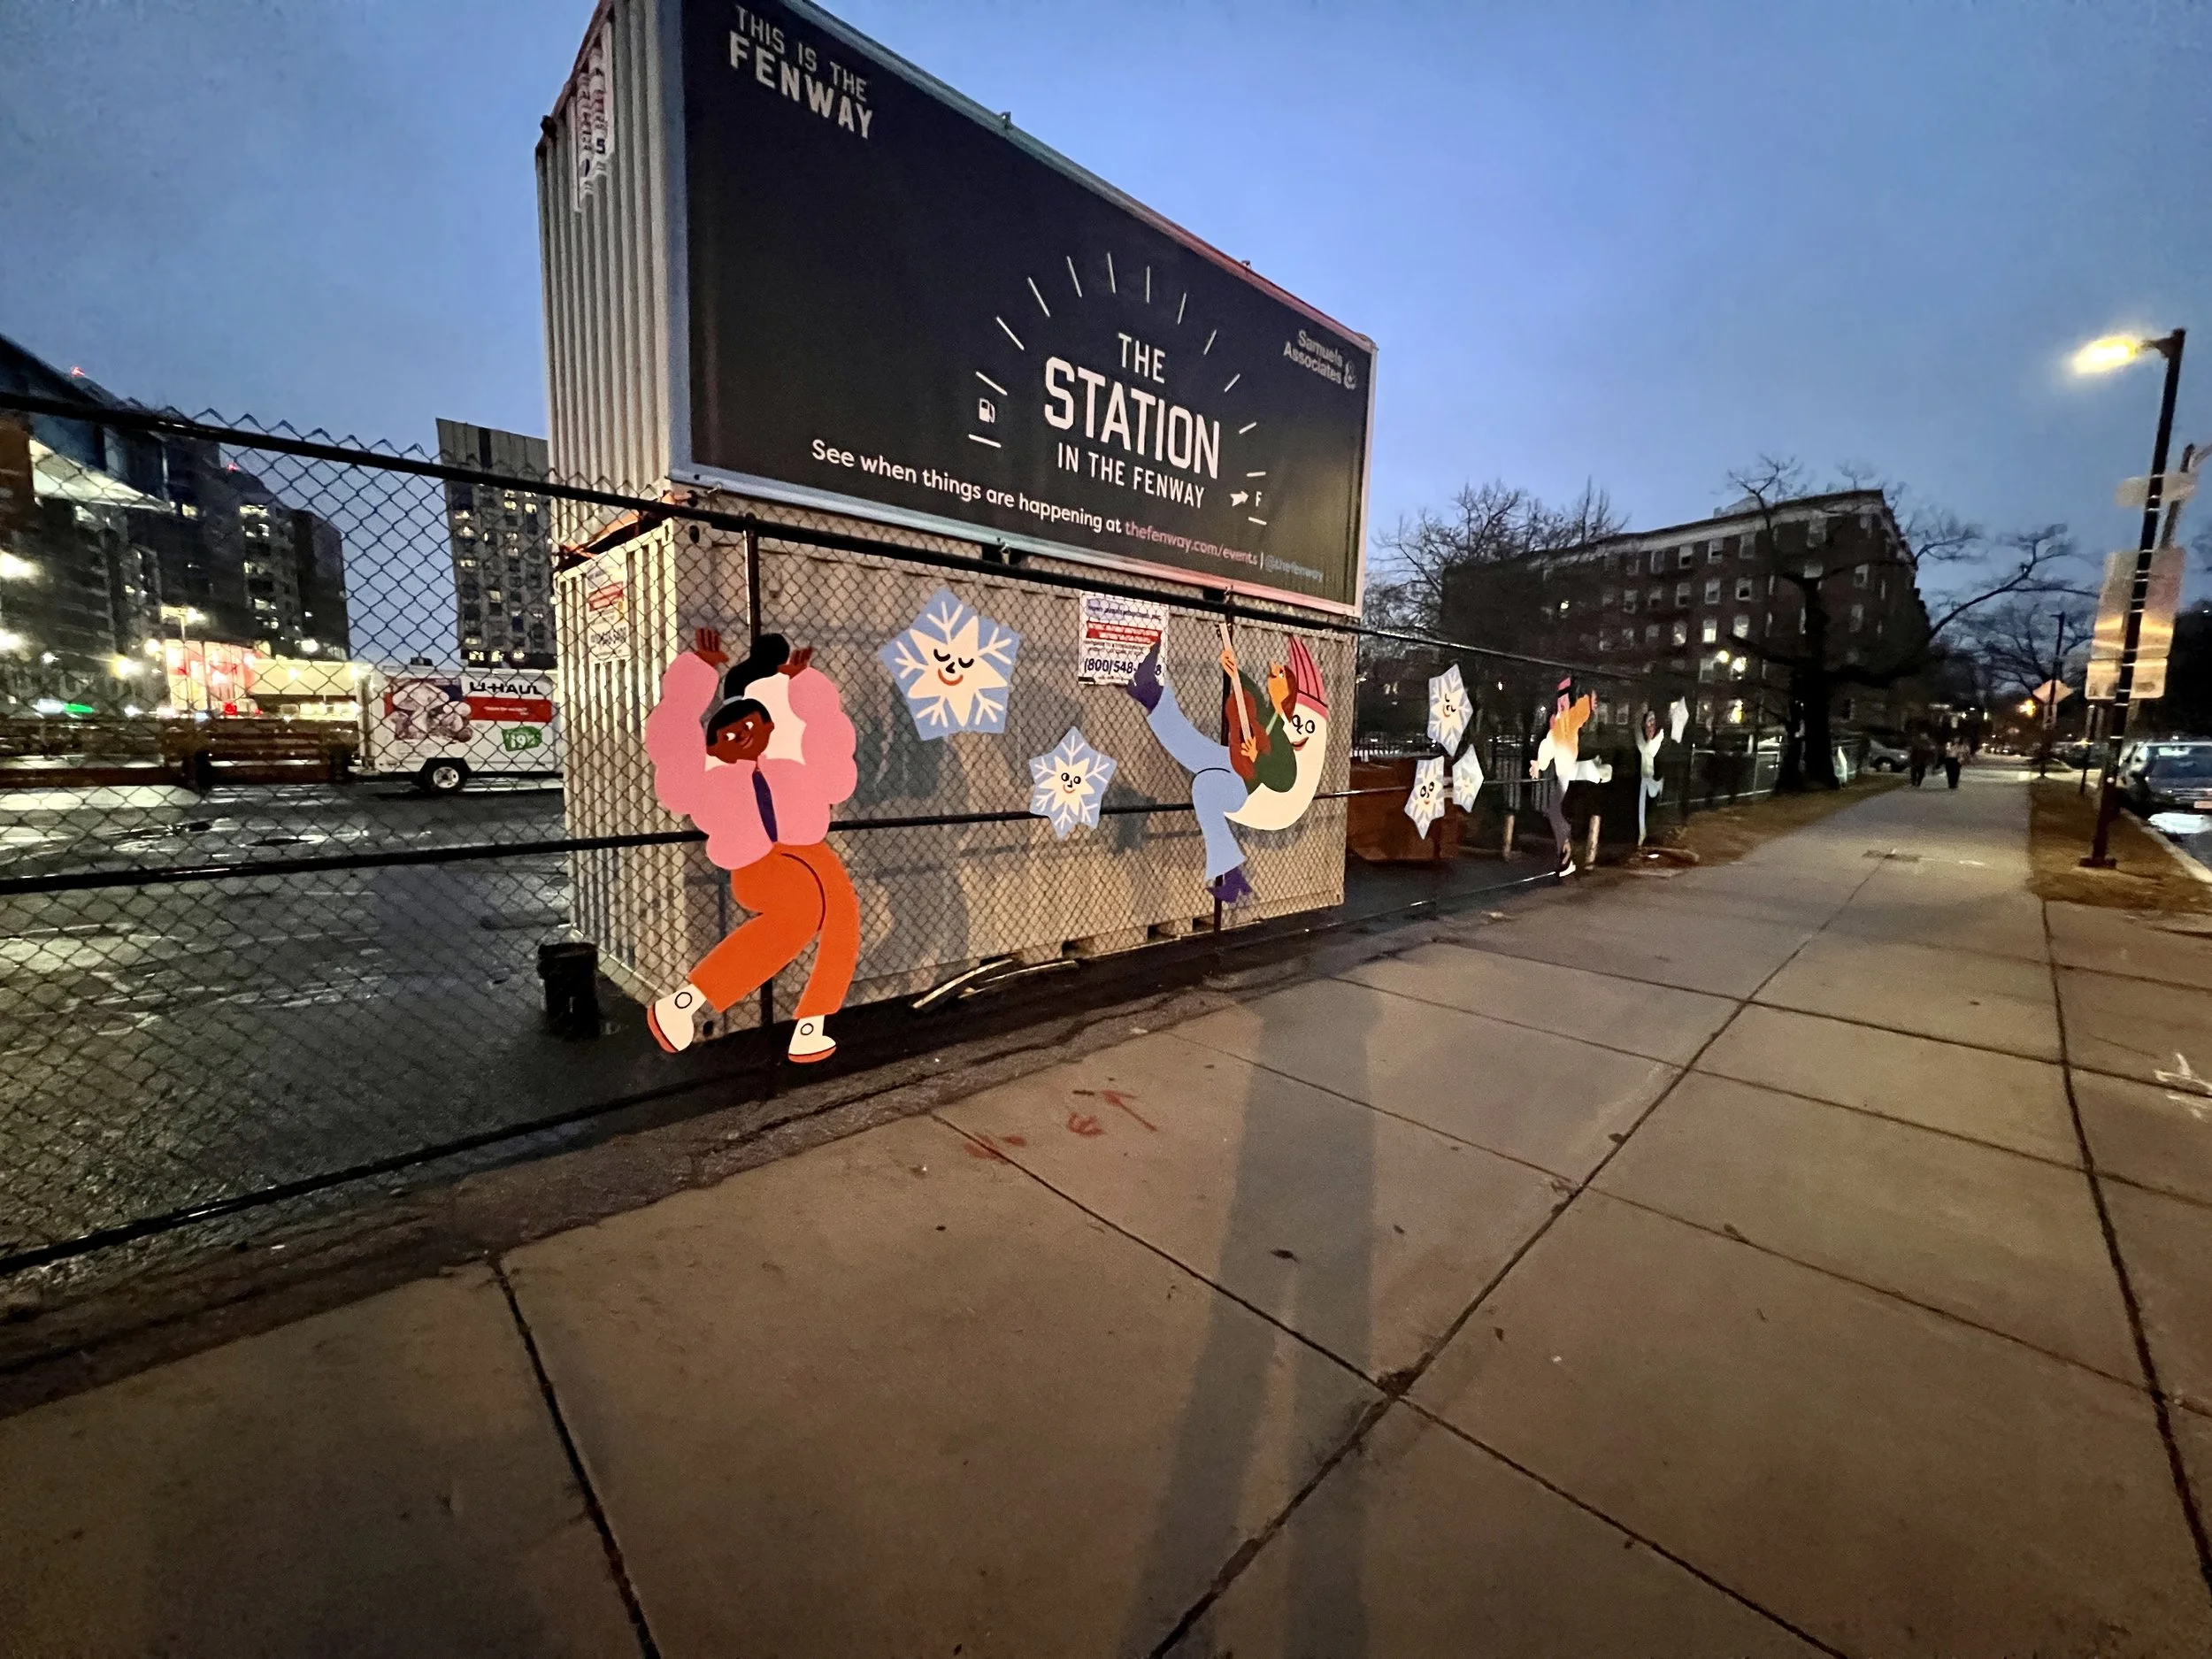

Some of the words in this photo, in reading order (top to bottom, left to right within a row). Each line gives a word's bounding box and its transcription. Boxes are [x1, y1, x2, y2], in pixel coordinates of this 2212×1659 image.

[736, 4, 785, 54] THIS
[799, 42, 817, 72] IS
[830, 61, 866, 102] THE
[730, 30, 873, 140] FENWAY
[1118, 332, 1165, 384] THE
[1283, 342, 1342, 384] Associates
[1298, 329, 1342, 368] Samuels
[1045, 356, 1220, 480] STATION
[1058, 442, 1079, 472] IN
[1087, 451, 1125, 486] THE
[1133, 465, 1204, 509] FENWAY
[1255, 490, 1263, 507] F
[812, 439, 855, 467] See
[860, 455, 917, 483] when
[922, 469, 981, 502] things
[987, 488, 1015, 507] are
[1019, 492, 1102, 533] happening
[1106, 518, 1122, 533] at
[1125, 521, 1257, 565] thefenway.com/events
[1264, 555, 1324, 583] @thefenway
[469, 681, 542, 695] U-HAUL
